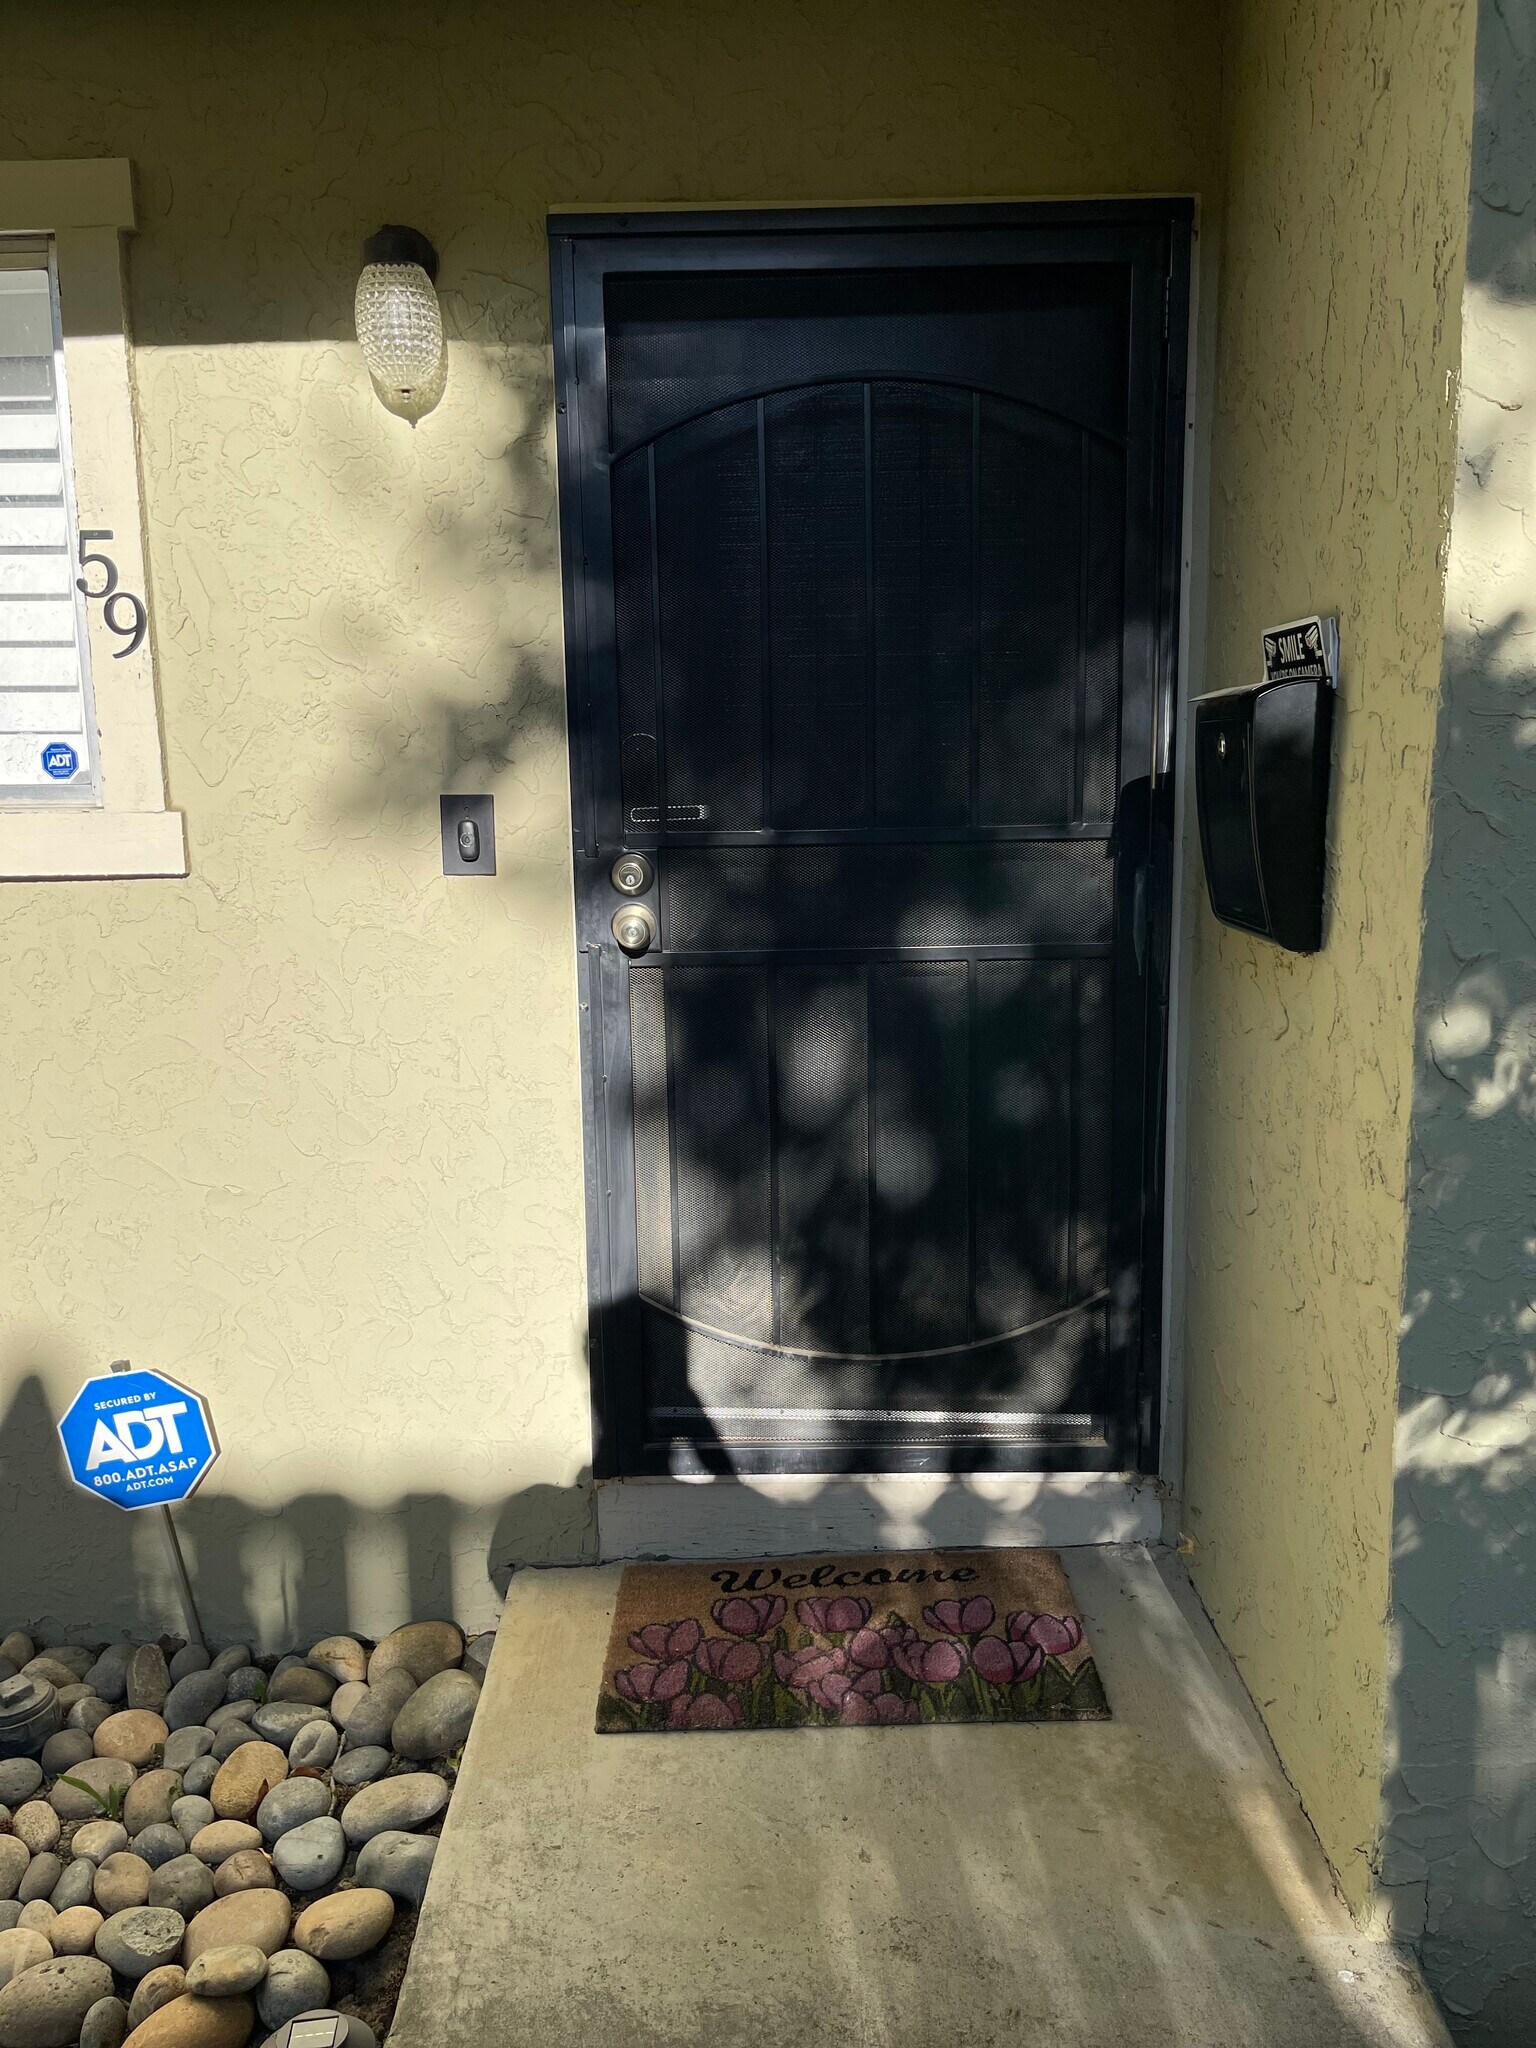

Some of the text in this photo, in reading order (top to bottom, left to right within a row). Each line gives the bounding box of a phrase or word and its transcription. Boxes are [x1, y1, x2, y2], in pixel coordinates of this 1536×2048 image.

[76, 530, 147, 659] 59
[1278, 632, 1305, 664] SMILE
[48, 753, 72, 767] ADT
[93, 1392, 156, 1411] SECURED BY
[85, 1401, 188, 1471] ADT
[93, 1457, 197, 1487] 800.ADT.ASAP
[126, 1475, 174, 1492] ADT.COM
[710, 1564, 981, 1593] Welcome
